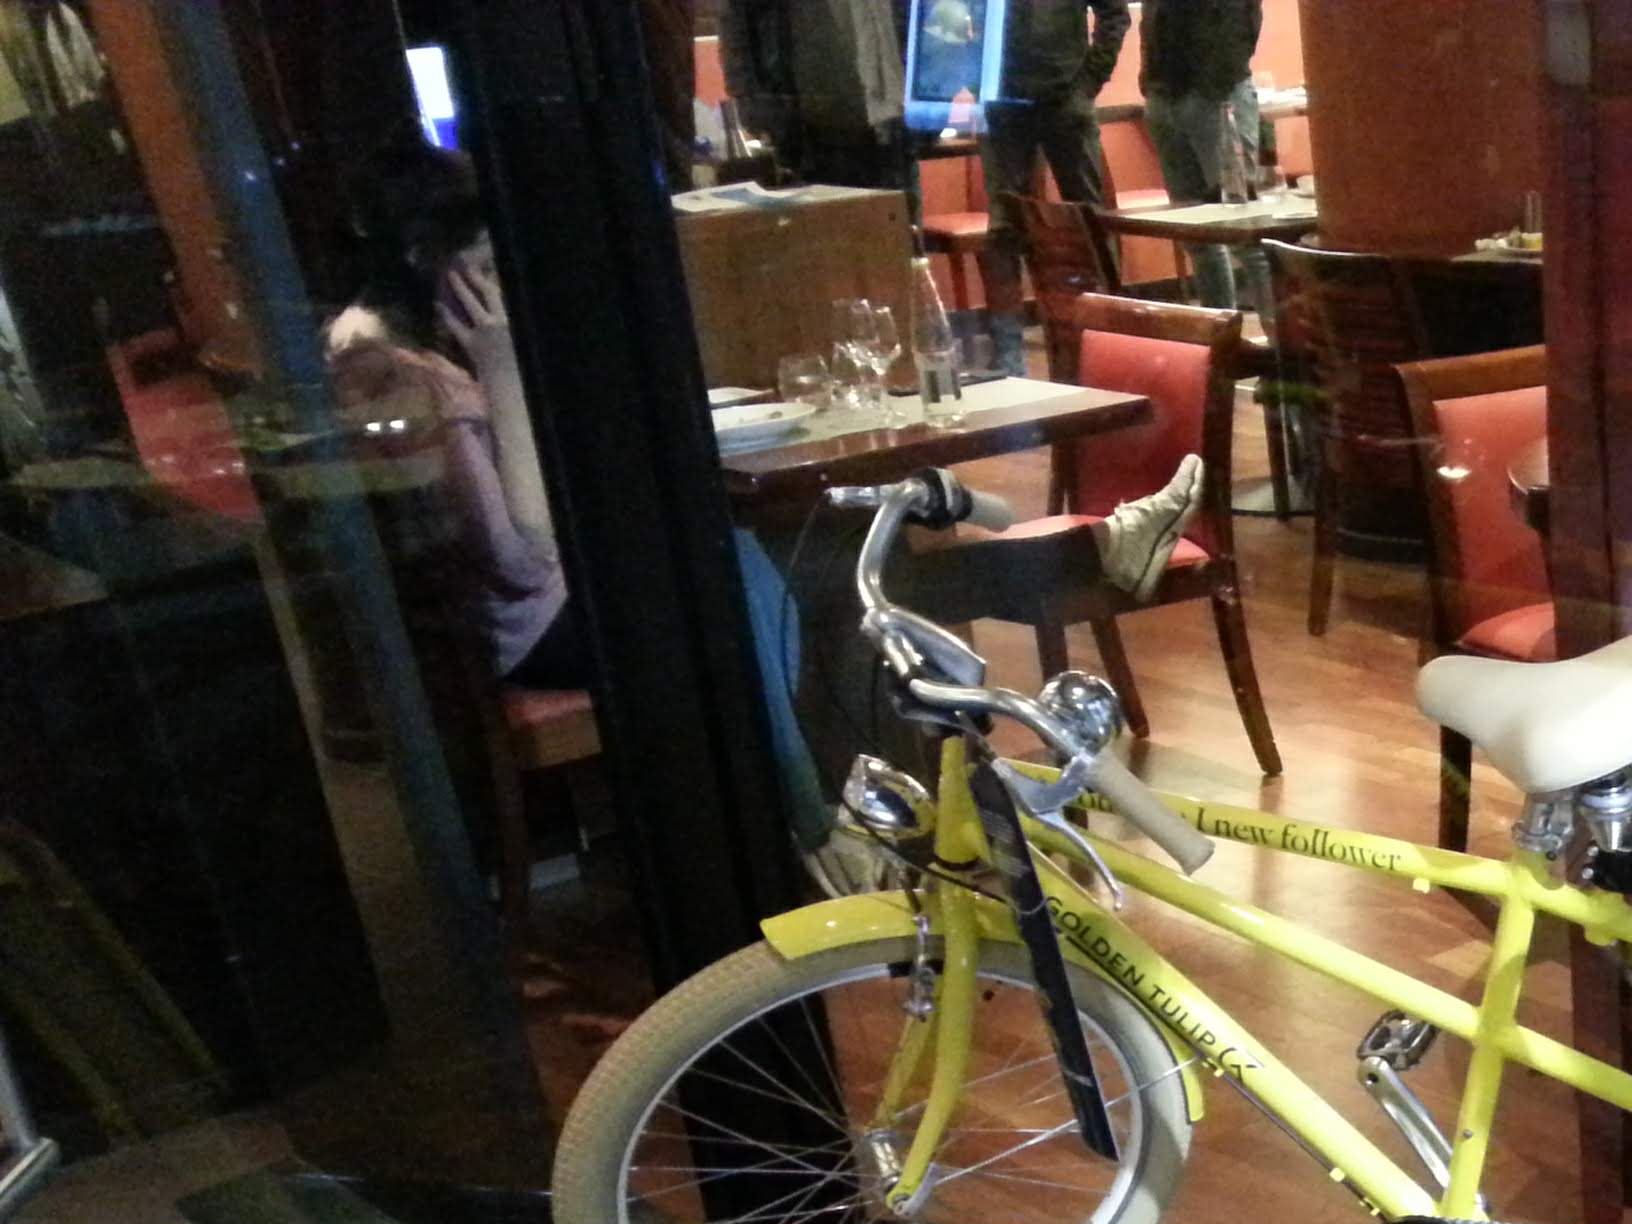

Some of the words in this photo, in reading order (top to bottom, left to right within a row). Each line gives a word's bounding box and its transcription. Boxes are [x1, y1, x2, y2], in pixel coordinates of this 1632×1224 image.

[1214, 819, 1274, 845] new
[1280, 823, 1401, 871] follower
[1045, 896, 1145, 987] GOLDEN
[1149, 983, 1217, 1046] TULIP
